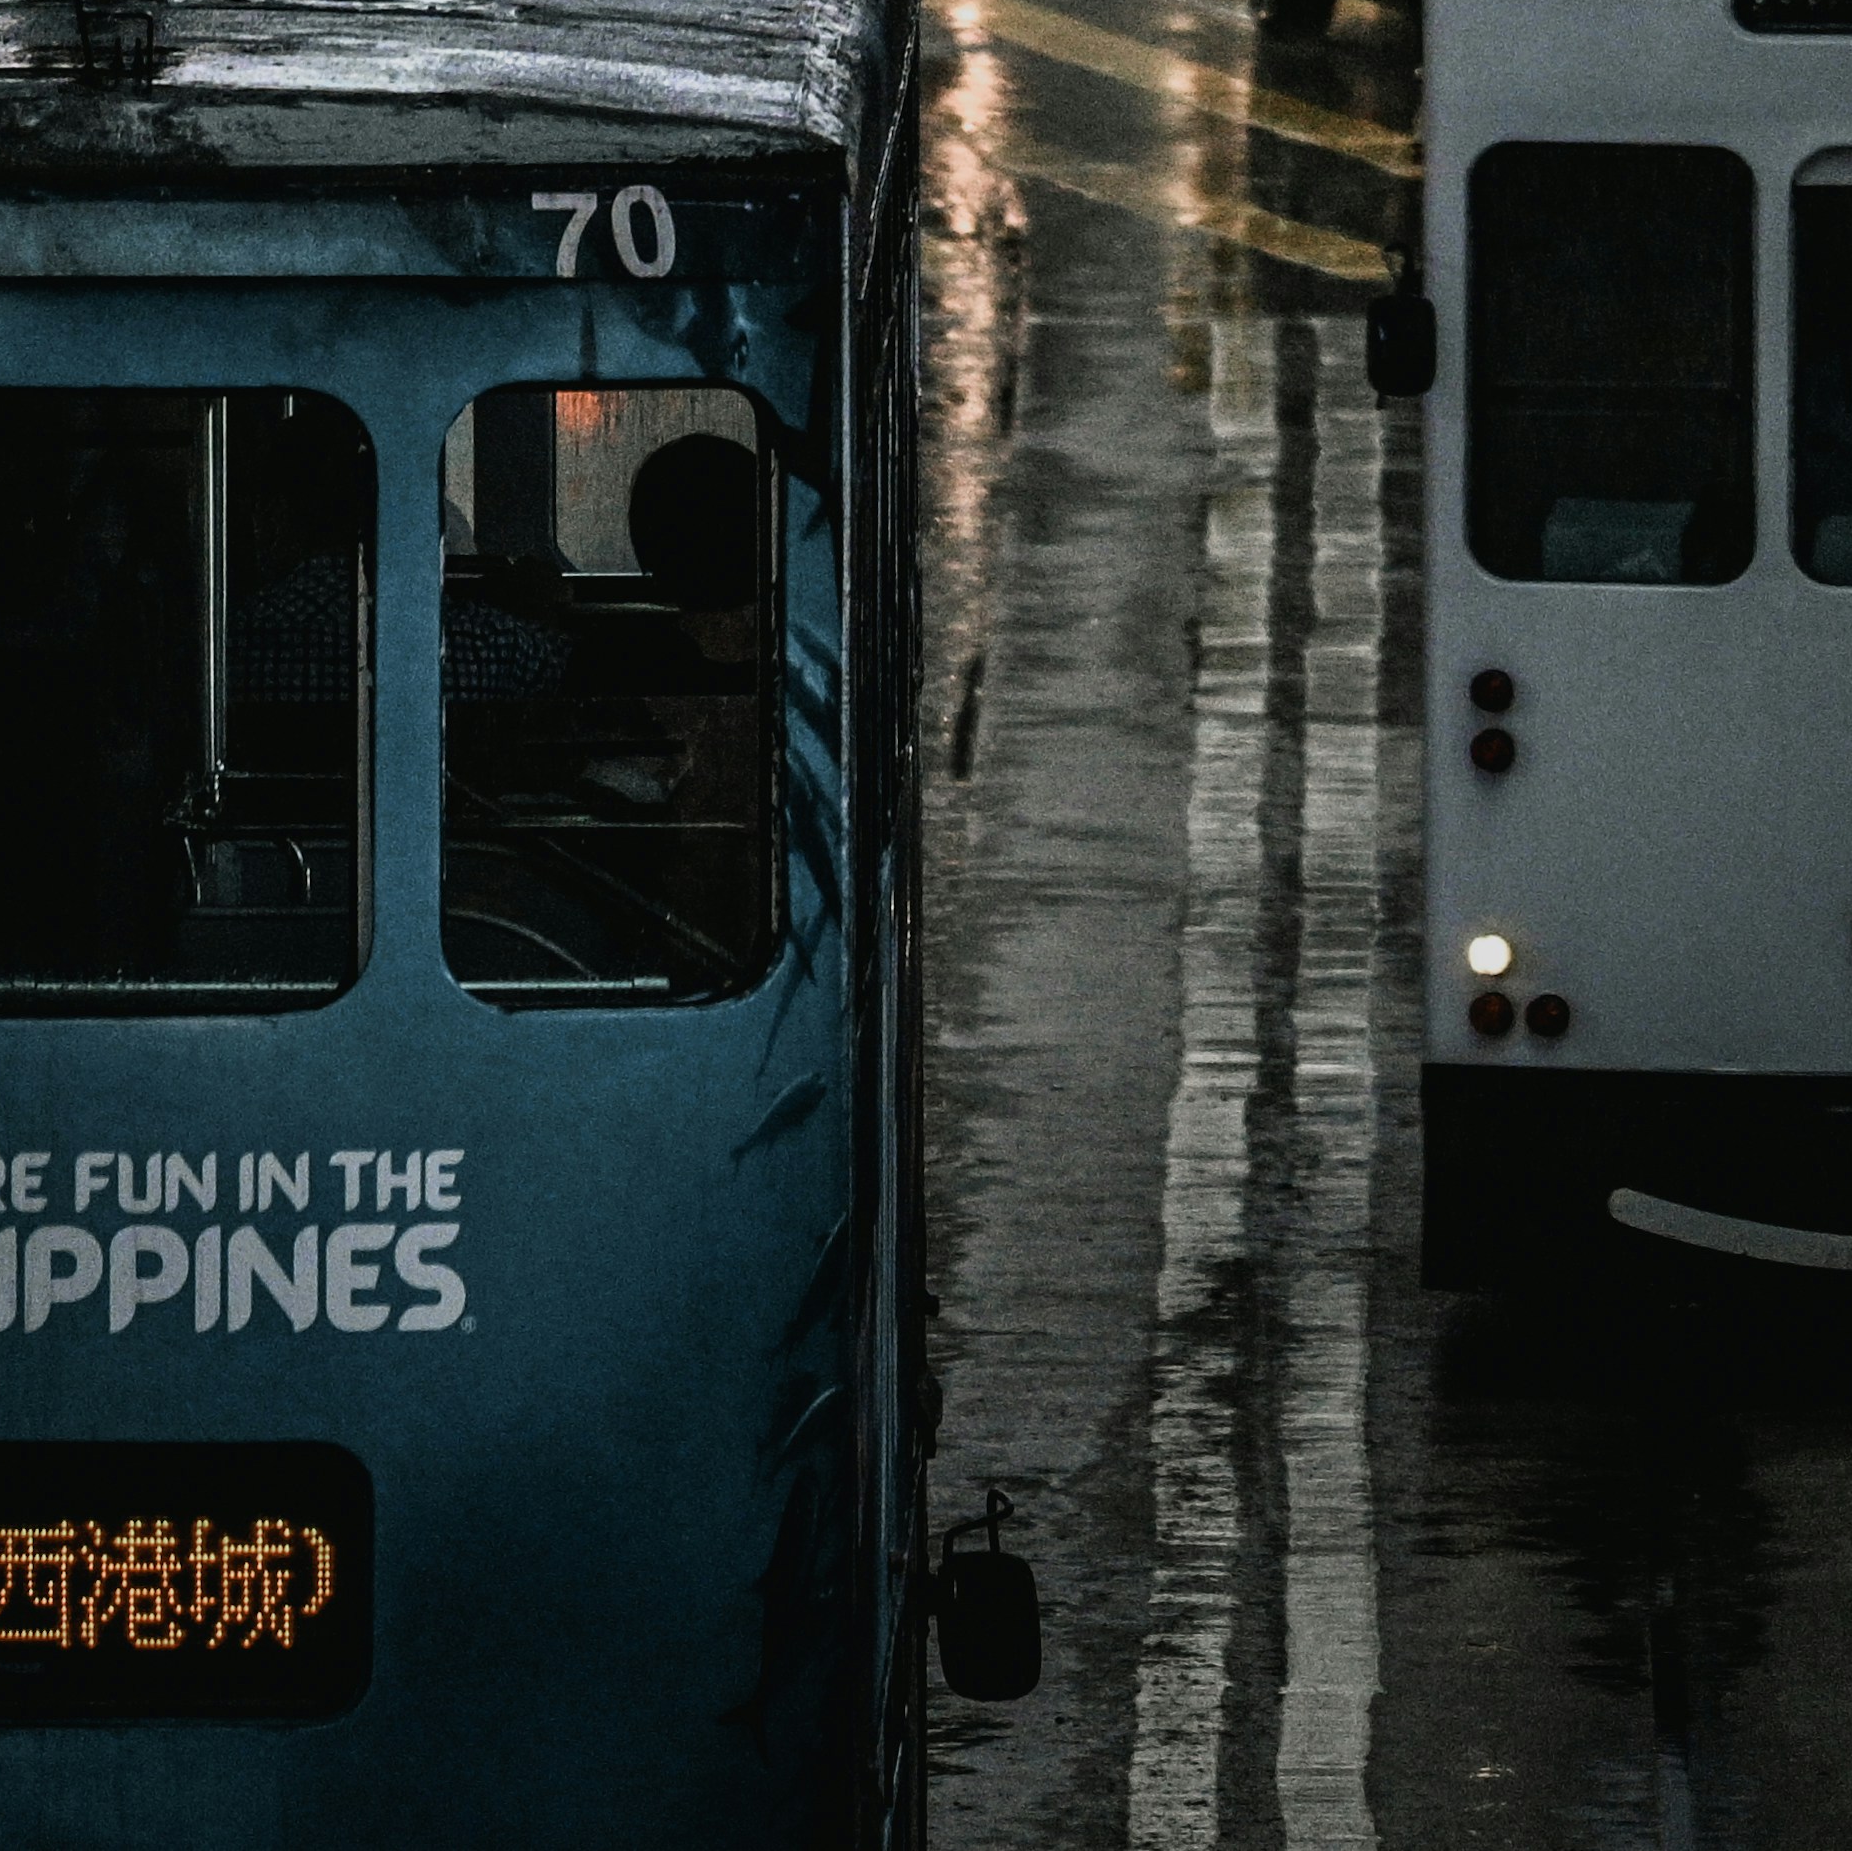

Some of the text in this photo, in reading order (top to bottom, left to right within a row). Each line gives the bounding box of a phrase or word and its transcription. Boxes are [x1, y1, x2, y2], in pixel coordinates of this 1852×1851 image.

[530, 186, 676, 280] 70
[73, 1151, 218, 1213] FUN
[238, 1150, 311, 1213] IN
[328, 1148, 467, 1212] THE
